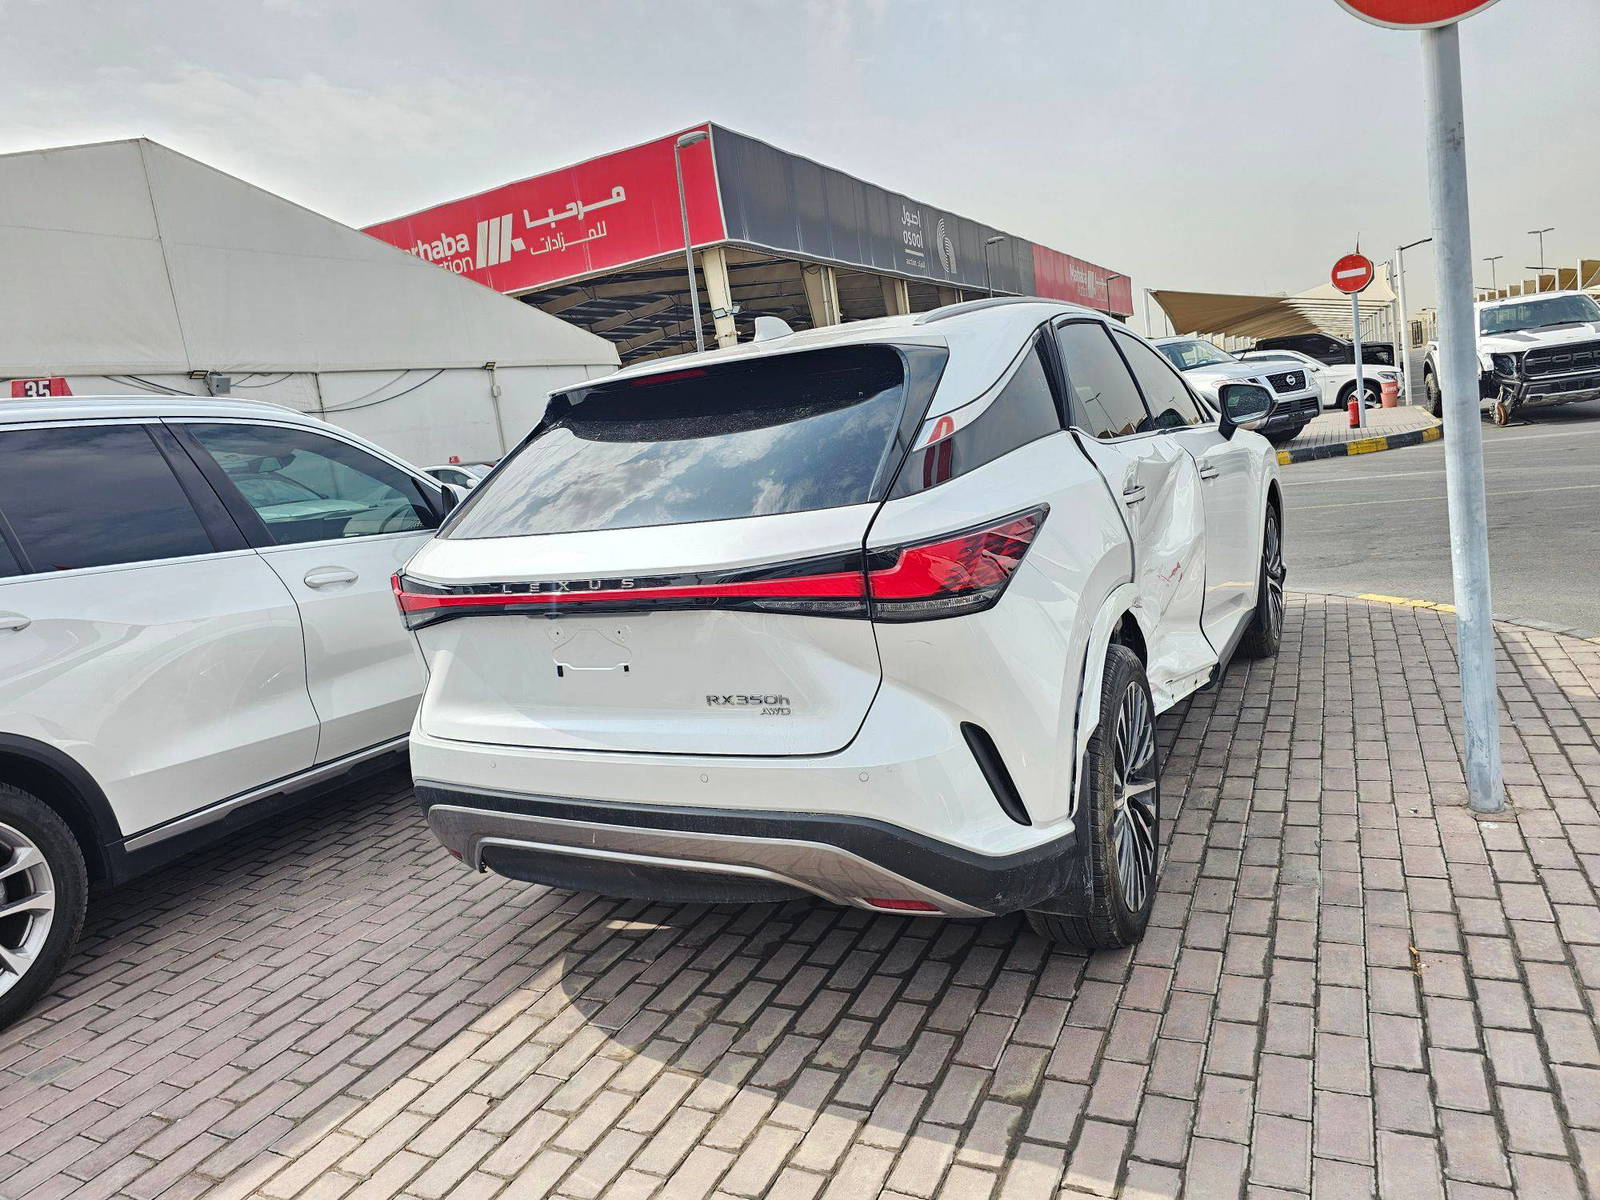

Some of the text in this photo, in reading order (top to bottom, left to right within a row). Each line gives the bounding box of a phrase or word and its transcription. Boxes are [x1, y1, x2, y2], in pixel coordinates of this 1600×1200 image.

[524, 186, 626, 229] مرحبا
[404, 232, 470, 261] rhaba
[530, 220, 607, 255] للمزادات
[24, 380, 50, 398] 35
[503, 578, 636, 594] LEXUS
[706, 693, 791, 707] RX350h
[760, 706, 791, 716] AWD
